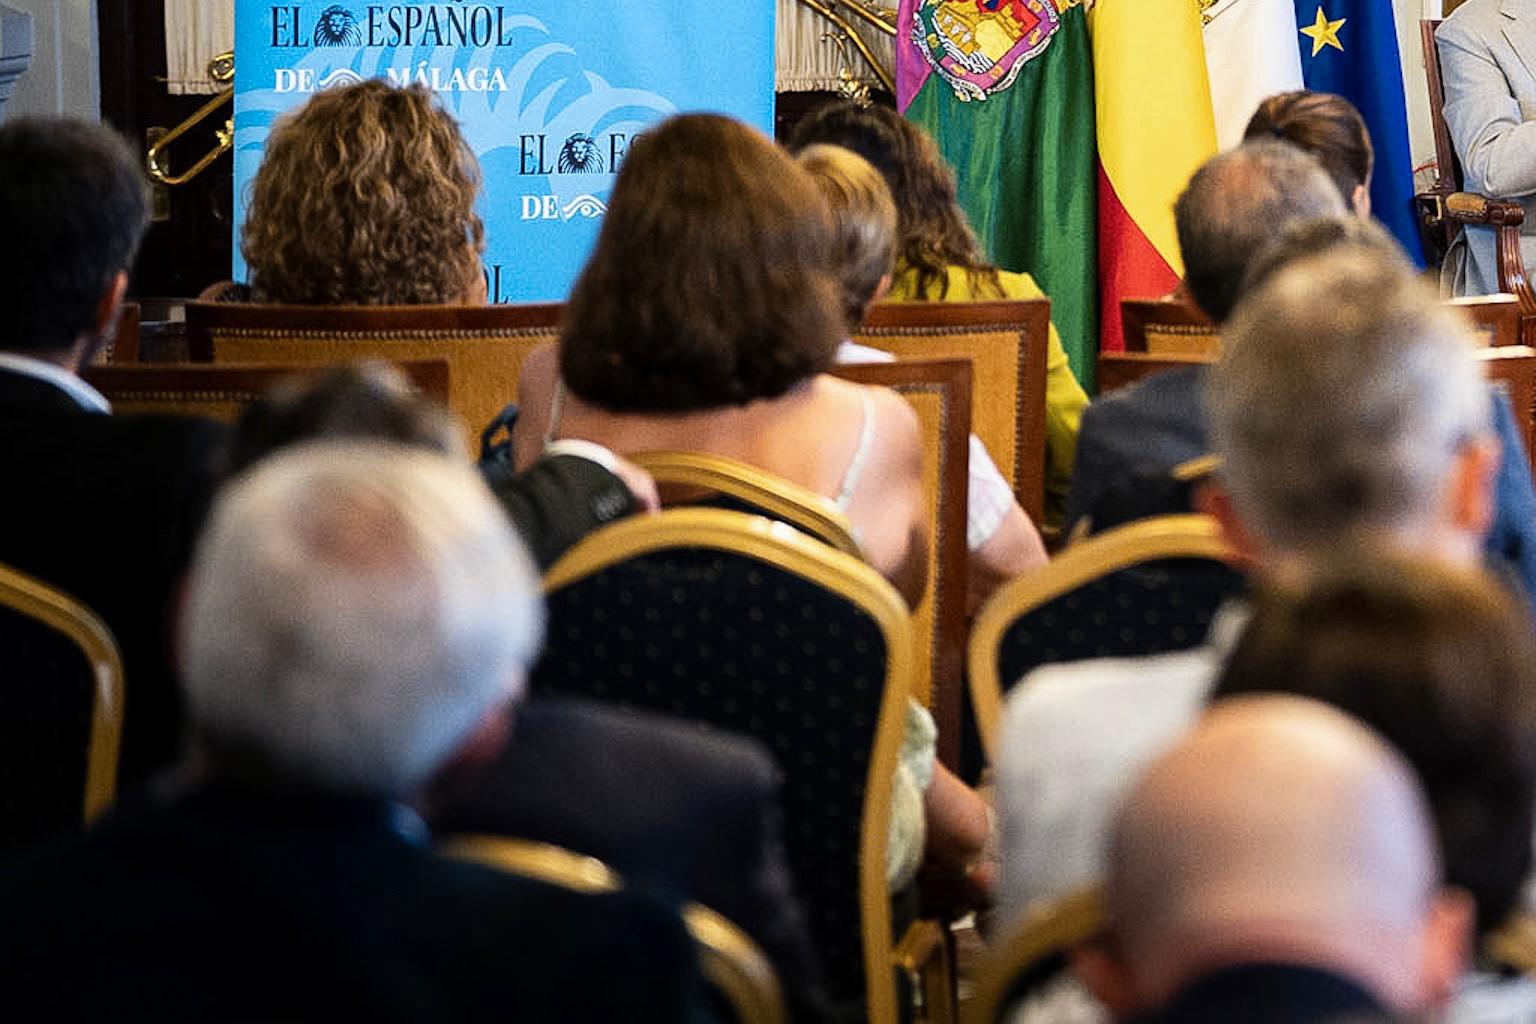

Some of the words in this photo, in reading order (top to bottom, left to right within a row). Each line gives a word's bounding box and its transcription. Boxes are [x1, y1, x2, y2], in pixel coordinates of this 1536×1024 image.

[270, 6, 309, 47] EL
[274, 69, 315, 93] DE
[518, 134, 553, 175] EL
[521, 196, 559, 220] DE
